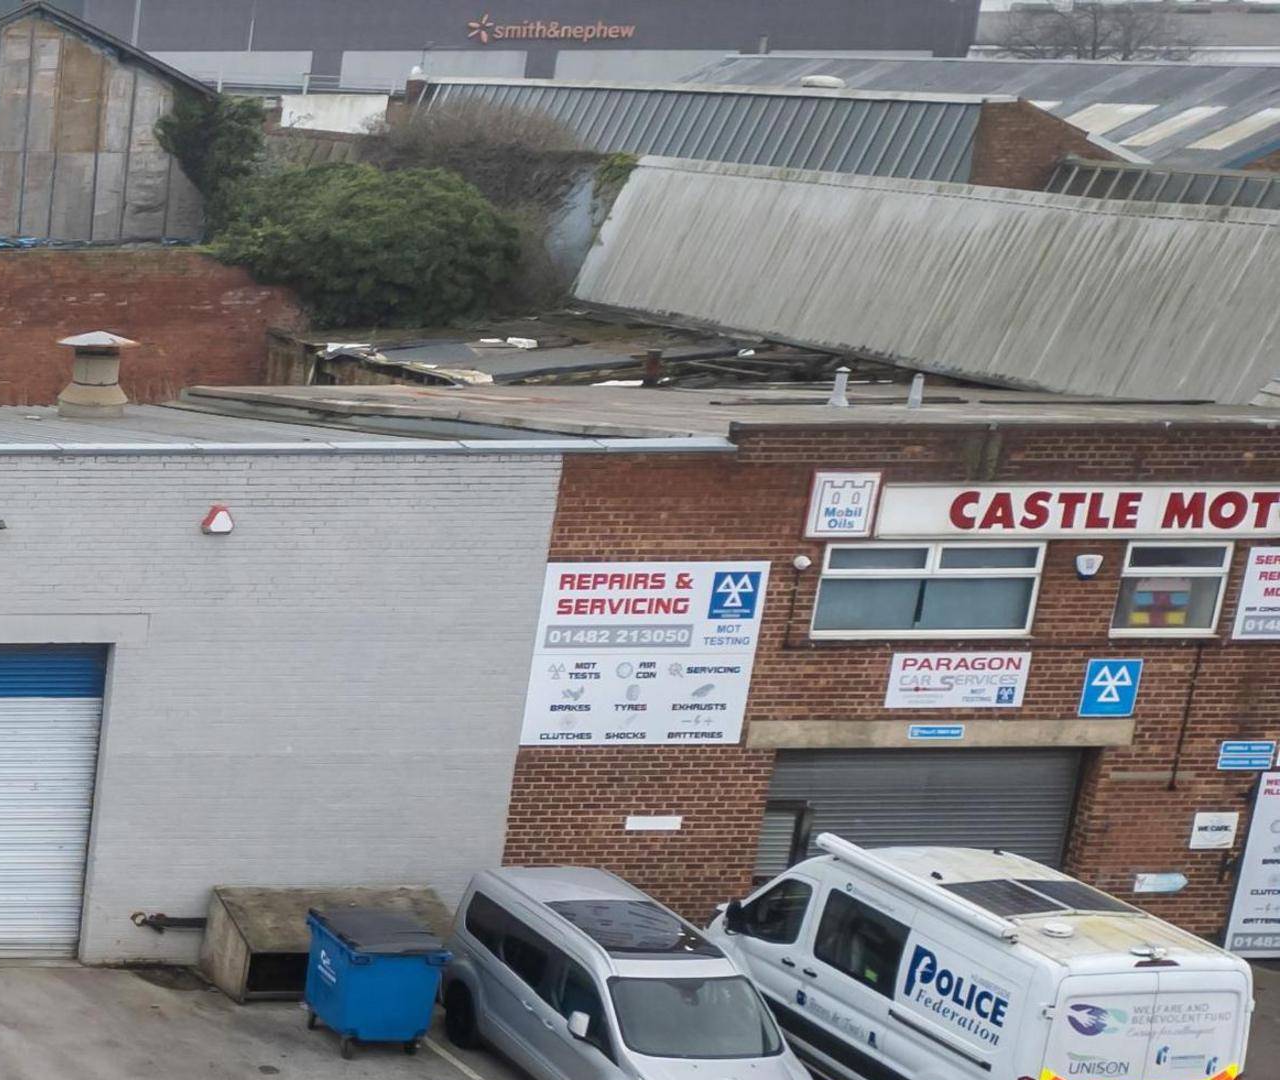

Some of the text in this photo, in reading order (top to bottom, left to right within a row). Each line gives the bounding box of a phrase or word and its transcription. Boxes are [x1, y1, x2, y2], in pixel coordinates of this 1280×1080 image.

[493, 20, 636, 42] smith&nephew
[824, 507, 862, 517] Mobil
[949, 491, 1280, 530] CASTLE MOT
[828, 518, 854, 528] Oils
[559, 573, 694, 590] REPAIRS &
[557, 598, 690, 615] SERVICING
[717, 625, 742, 634] MOT
[549, 629, 689, 643] 01482 213050
[704, 637, 750, 646] TESTING
[902, 657, 1022, 671] PARAGON
[686, 666, 741, 674] SERVICING
[899, 674, 1020, 691] CAR SERVICES
[671, 703, 727, 711] EXHAUSTS
[540, 732, 592, 740] CLUTCHES
[605, 732, 646, 740] SHOCKS
[667, 731, 723, 739] BATTERIES
[1133, 1002, 1210, 1013] WELFARE AND
[915, 988, 1001, 1046] Federation
[1068, 1061, 1130, 1075] UNISON
